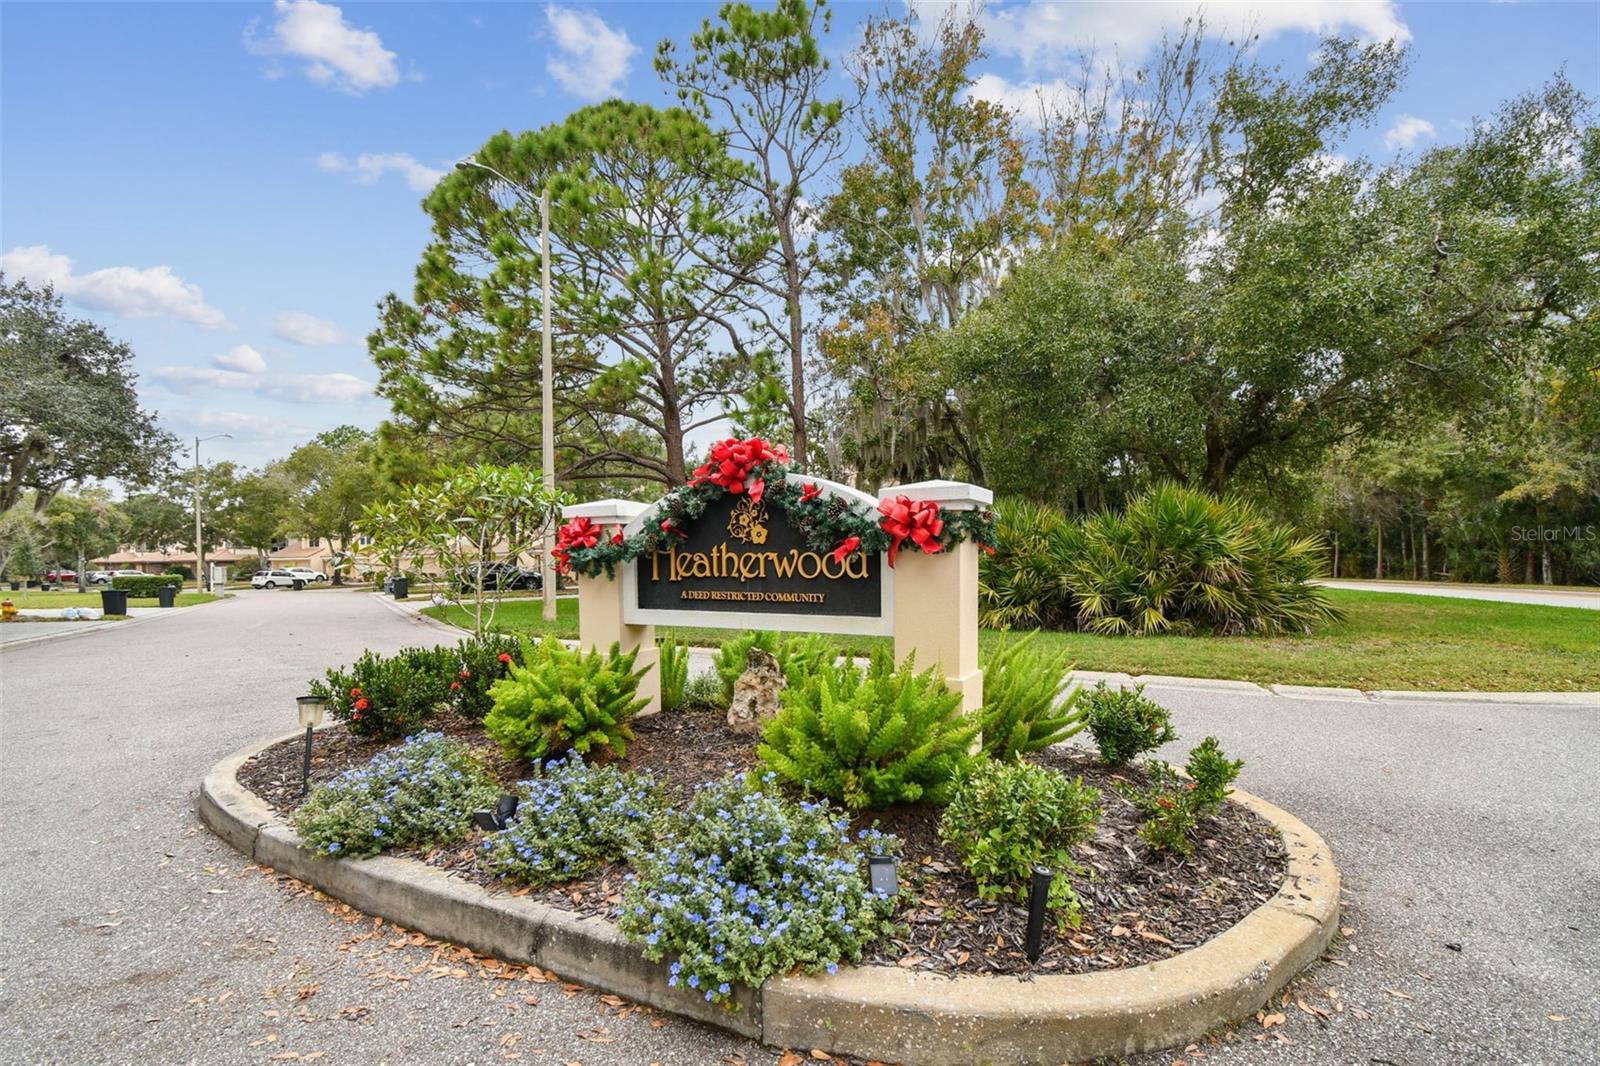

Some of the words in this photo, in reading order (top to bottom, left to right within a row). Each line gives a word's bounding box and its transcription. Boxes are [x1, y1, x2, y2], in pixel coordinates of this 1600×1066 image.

[649, 541, 870, 582] Heatherwood
[680, 590, 688, 600] A
[688, 590, 710, 600] DEED
[711, 590, 764, 601] RESTRICTED
[764, 592, 825, 603] COMMUNITY
